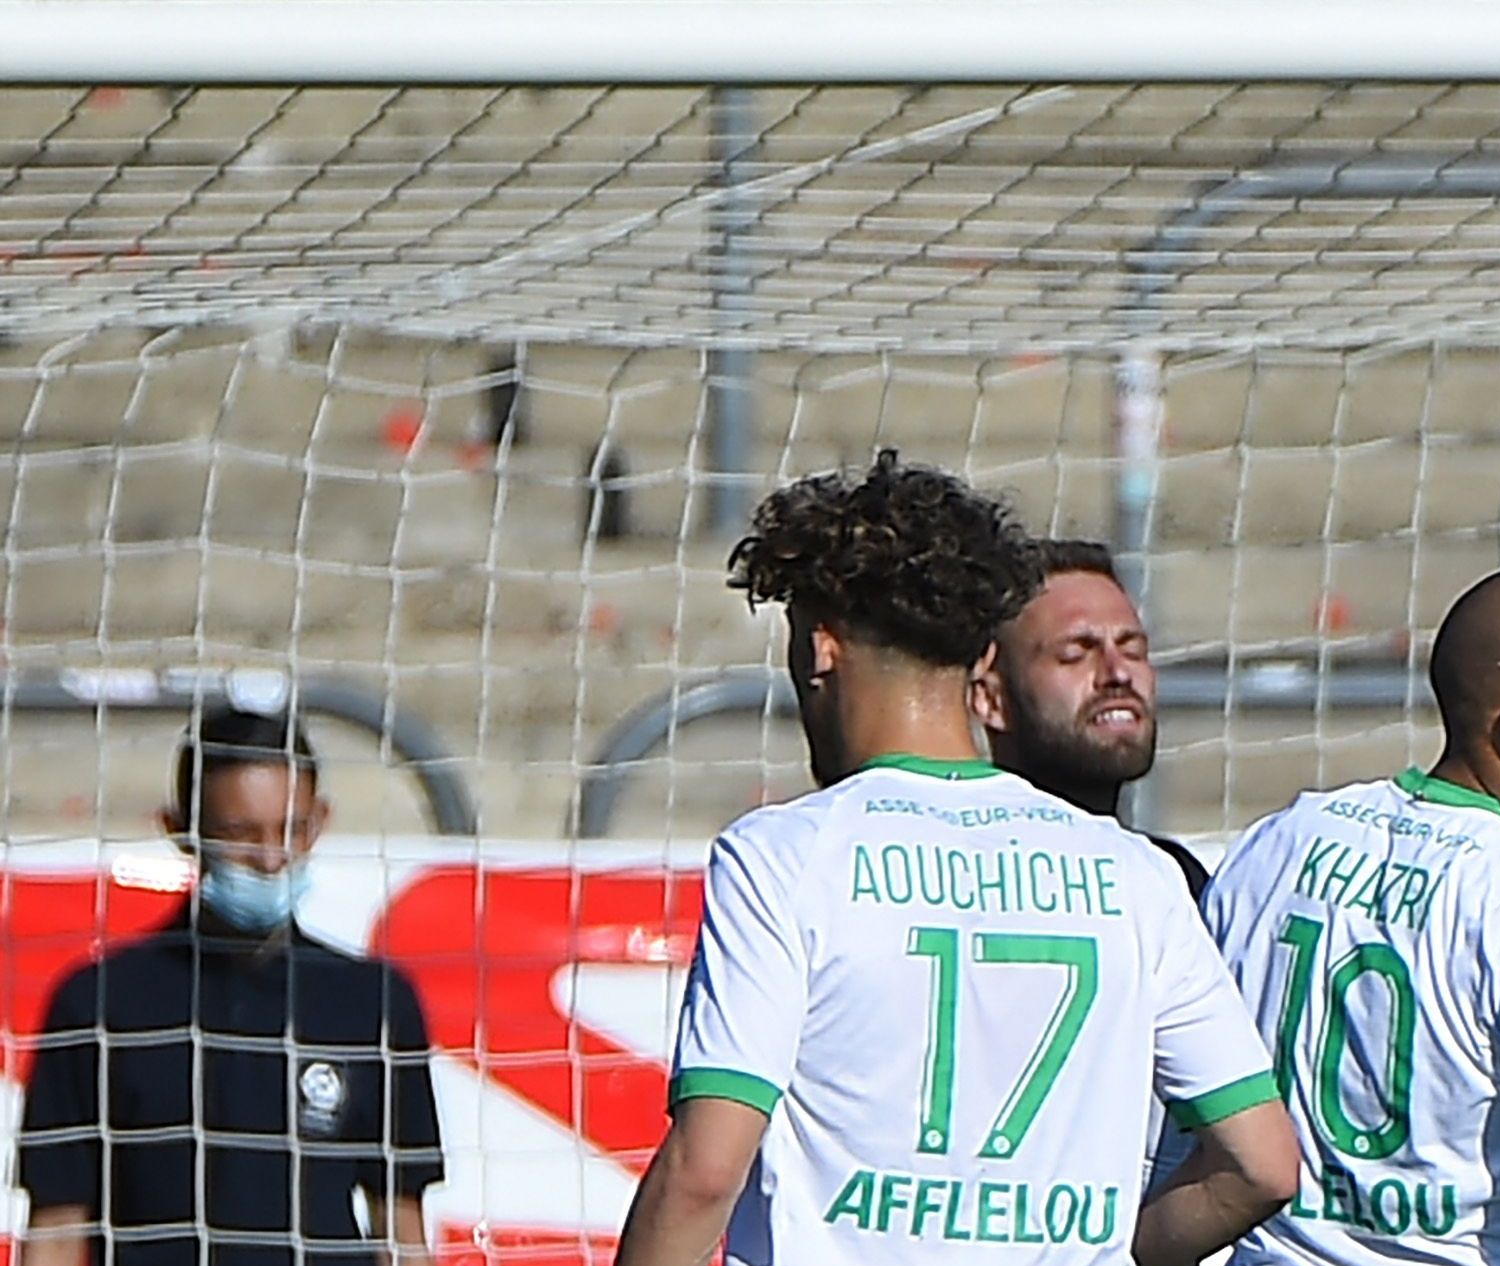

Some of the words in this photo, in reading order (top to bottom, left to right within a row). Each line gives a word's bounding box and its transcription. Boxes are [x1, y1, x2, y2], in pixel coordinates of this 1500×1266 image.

[852, 839, 1122, 916] AOUCHICHE
[907, 925, 1099, 1160] 17
[1272, 913, 1417, 1161] 10
[824, 1169, 1118, 1246] AFFLELOU
[1289, 1162, 1457, 1237] LELOU
